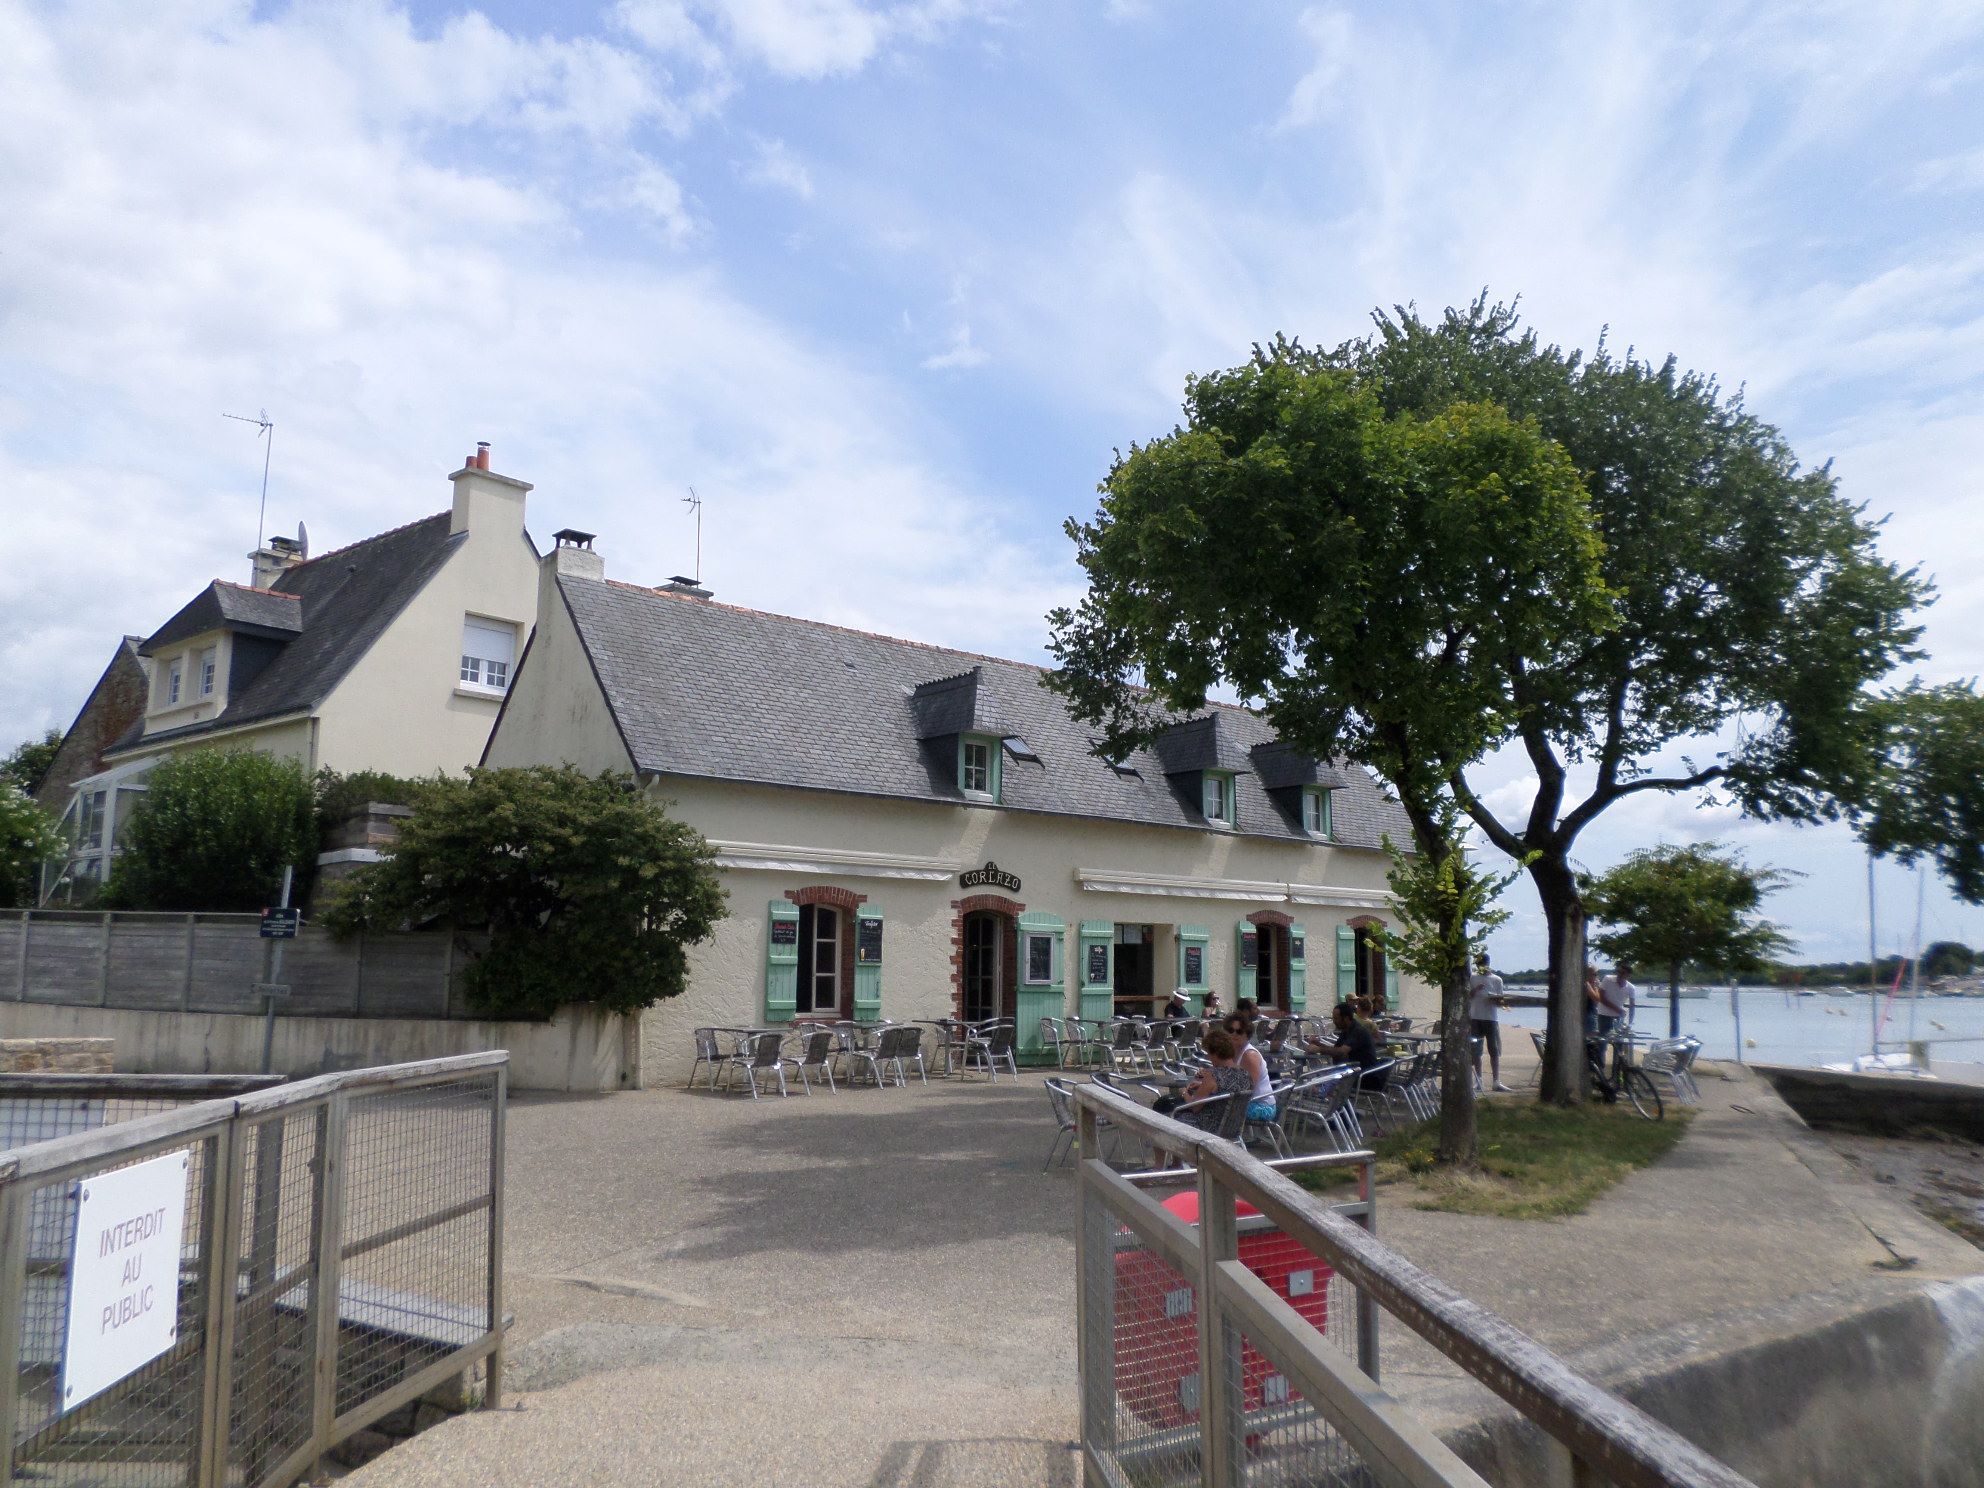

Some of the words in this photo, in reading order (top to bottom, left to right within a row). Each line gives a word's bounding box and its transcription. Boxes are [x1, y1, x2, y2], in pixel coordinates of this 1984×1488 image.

[965, 871, 1018, 889] CORLAZO
[99, 1207, 166, 1258] INTERDIT
[121, 1252, 143, 1287] AU
[101, 1284, 154, 1335] PUBLIC
